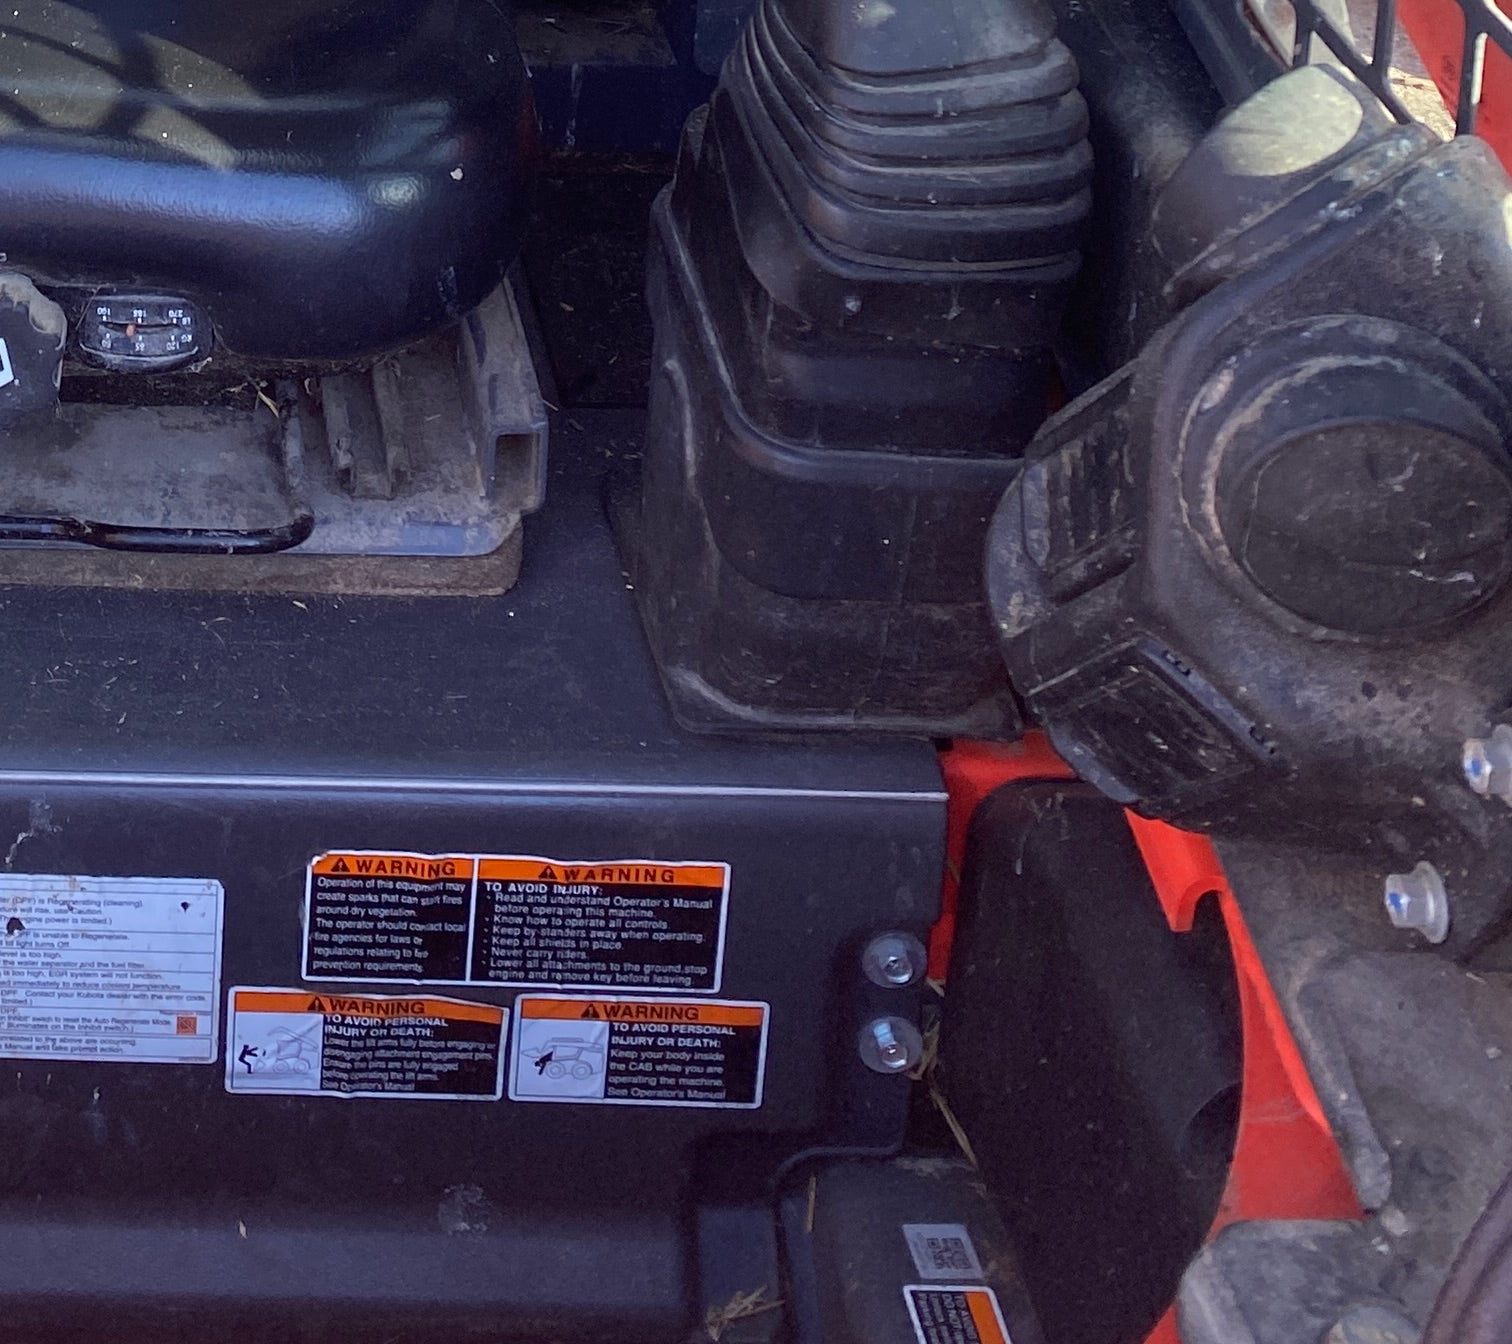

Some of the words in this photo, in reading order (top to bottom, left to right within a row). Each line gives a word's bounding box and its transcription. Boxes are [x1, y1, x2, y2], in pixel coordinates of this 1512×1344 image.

[356, 859, 455, 877] WARNING
[564, 868, 674, 883] WARNING
[317, 877, 363, 888] Operation
[366, 879, 375, 888] of
[377, 879, 394, 889] this
[446, 883, 465, 893] may
[485, 882, 502, 892] TO
[508, 883, 547, 892] AVOID
[553, 885, 603, 895] INJURY:
[317, 892, 346, 901] create
[348, 893, 379, 903] sparks
[381, 893, 399, 903] that
[401, 896, 418, 904] can
[443, 895, 462, 905] fires
[495, 892, 524, 903] Read
[527, 895, 547, 903] and
[550, 896, 610, 905] understand
[614, 896, 669, 908] Operator's
[673, 898, 712, 909] Manual
[316, 905, 348, 914] around
[495, 904, 529, 913] before
[532, 906, 582, 917] operating
[586, 907, 605, 916] this
[316, 918, 333, 928] The
[336, 920, 374, 930] operator
[377, 920, 407, 930] should
[444, 922, 465, 932] local
[494, 915, 523, 924] Know
[526, 916, 548, 925] how
[552, 917, 561, 925] to
[564, 918, 605, 928] operate
[609, 919, 622, 927] all
[332, 933, 372, 943] agencies
[376, 934, 387, 943] for
[390, 935, 410, 944] laws
[414, 937, 423, 945] or
[493, 926, 520, 936] Keep
[590, 931, 617, 939] away
[621, 931, 649, 939] when
[492, 936, 520, 947] Keep
[523, 938, 536, 946] all
[539, 939, 576, 947] shields
[580, 939, 589, 948] in
[314, 946, 364, 957] regulations
[367, 947, 400, 959] relating
[403, 948, 412, 958] to
[491, 947, 523, 956] Never
[526, 949, 554, 959] carry
[313, 960, 361, 971] prevention
[490, 958, 523, 967] Lower
[526, 960, 539, 968] all
[542, 960, 606, 970] attachments
[610, 963, 620, 971] to
[623, 963, 640, 972] the
[489, 970, 525, 980] engine
[528, 971, 548, 979] and
[552, 972, 590, 981] remove
[593, 973, 612, 983] key
[616, 973, 649, 982] before
[329, 999, 425, 1014] WARNING
[603, 1004, 699, 1020] WARNING
[325, 1015, 341, 1023] TO
[345, 1016, 381, 1027] AVOID
[324, 1026, 366, 1036] INJURY
[613, 1022, 629, 1031] TO
[632, 1023, 669, 1033] AVOID
[671, 1024, 736, 1035] PERSONAL
[611, 1037, 654, 1046] INJURY
[657, 1038, 675, 1046] OR
[611, 1049, 638, 1059] Keep
[641, 1051, 664, 1060] your
[666, 1050, 691, 1061] body
[694, 1051, 724, 1061] inside
[610, 1062, 625, 1071] the
[629, 1063, 652, 1071] CAB
[655, 1064, 682, 1073] while
[685, 1065, 704, 1074] you
[707, 1066, 723, 1074] are
[660, 1076, 676, 1085] the
[607, 1087, 628, 1096] See
[687, 1089, 726, 1099] Manual
